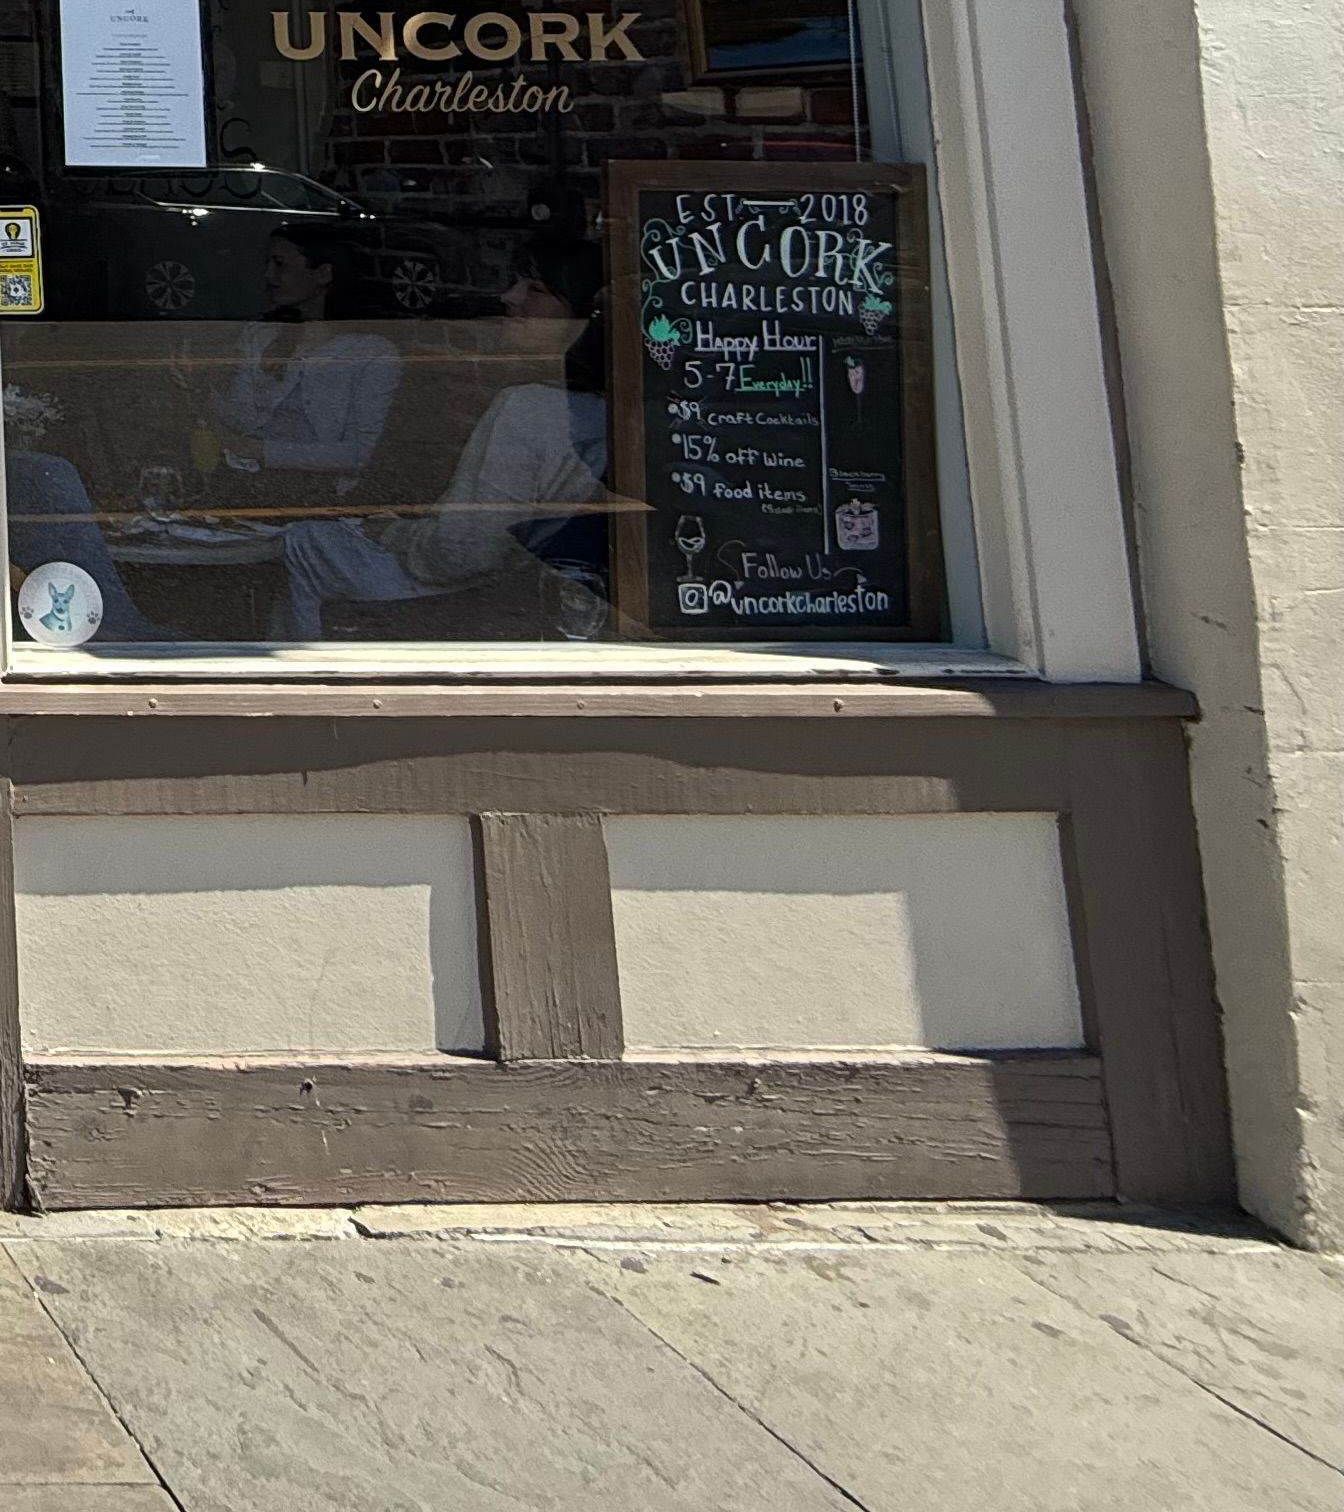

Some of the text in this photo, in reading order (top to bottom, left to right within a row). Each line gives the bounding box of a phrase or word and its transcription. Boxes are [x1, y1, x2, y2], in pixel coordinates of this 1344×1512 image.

[270, 11, 646, 61] UNCORK
[351, 68, 574, 113] Charleston
[800, 194, 869, 225] 2018
[649, 215, 893, 295] UNCORK
[680, 281, 854, 315] CHARLESTON
[759, 485, 806, 501] items
[741, 552, 831, 580] Follow Us
